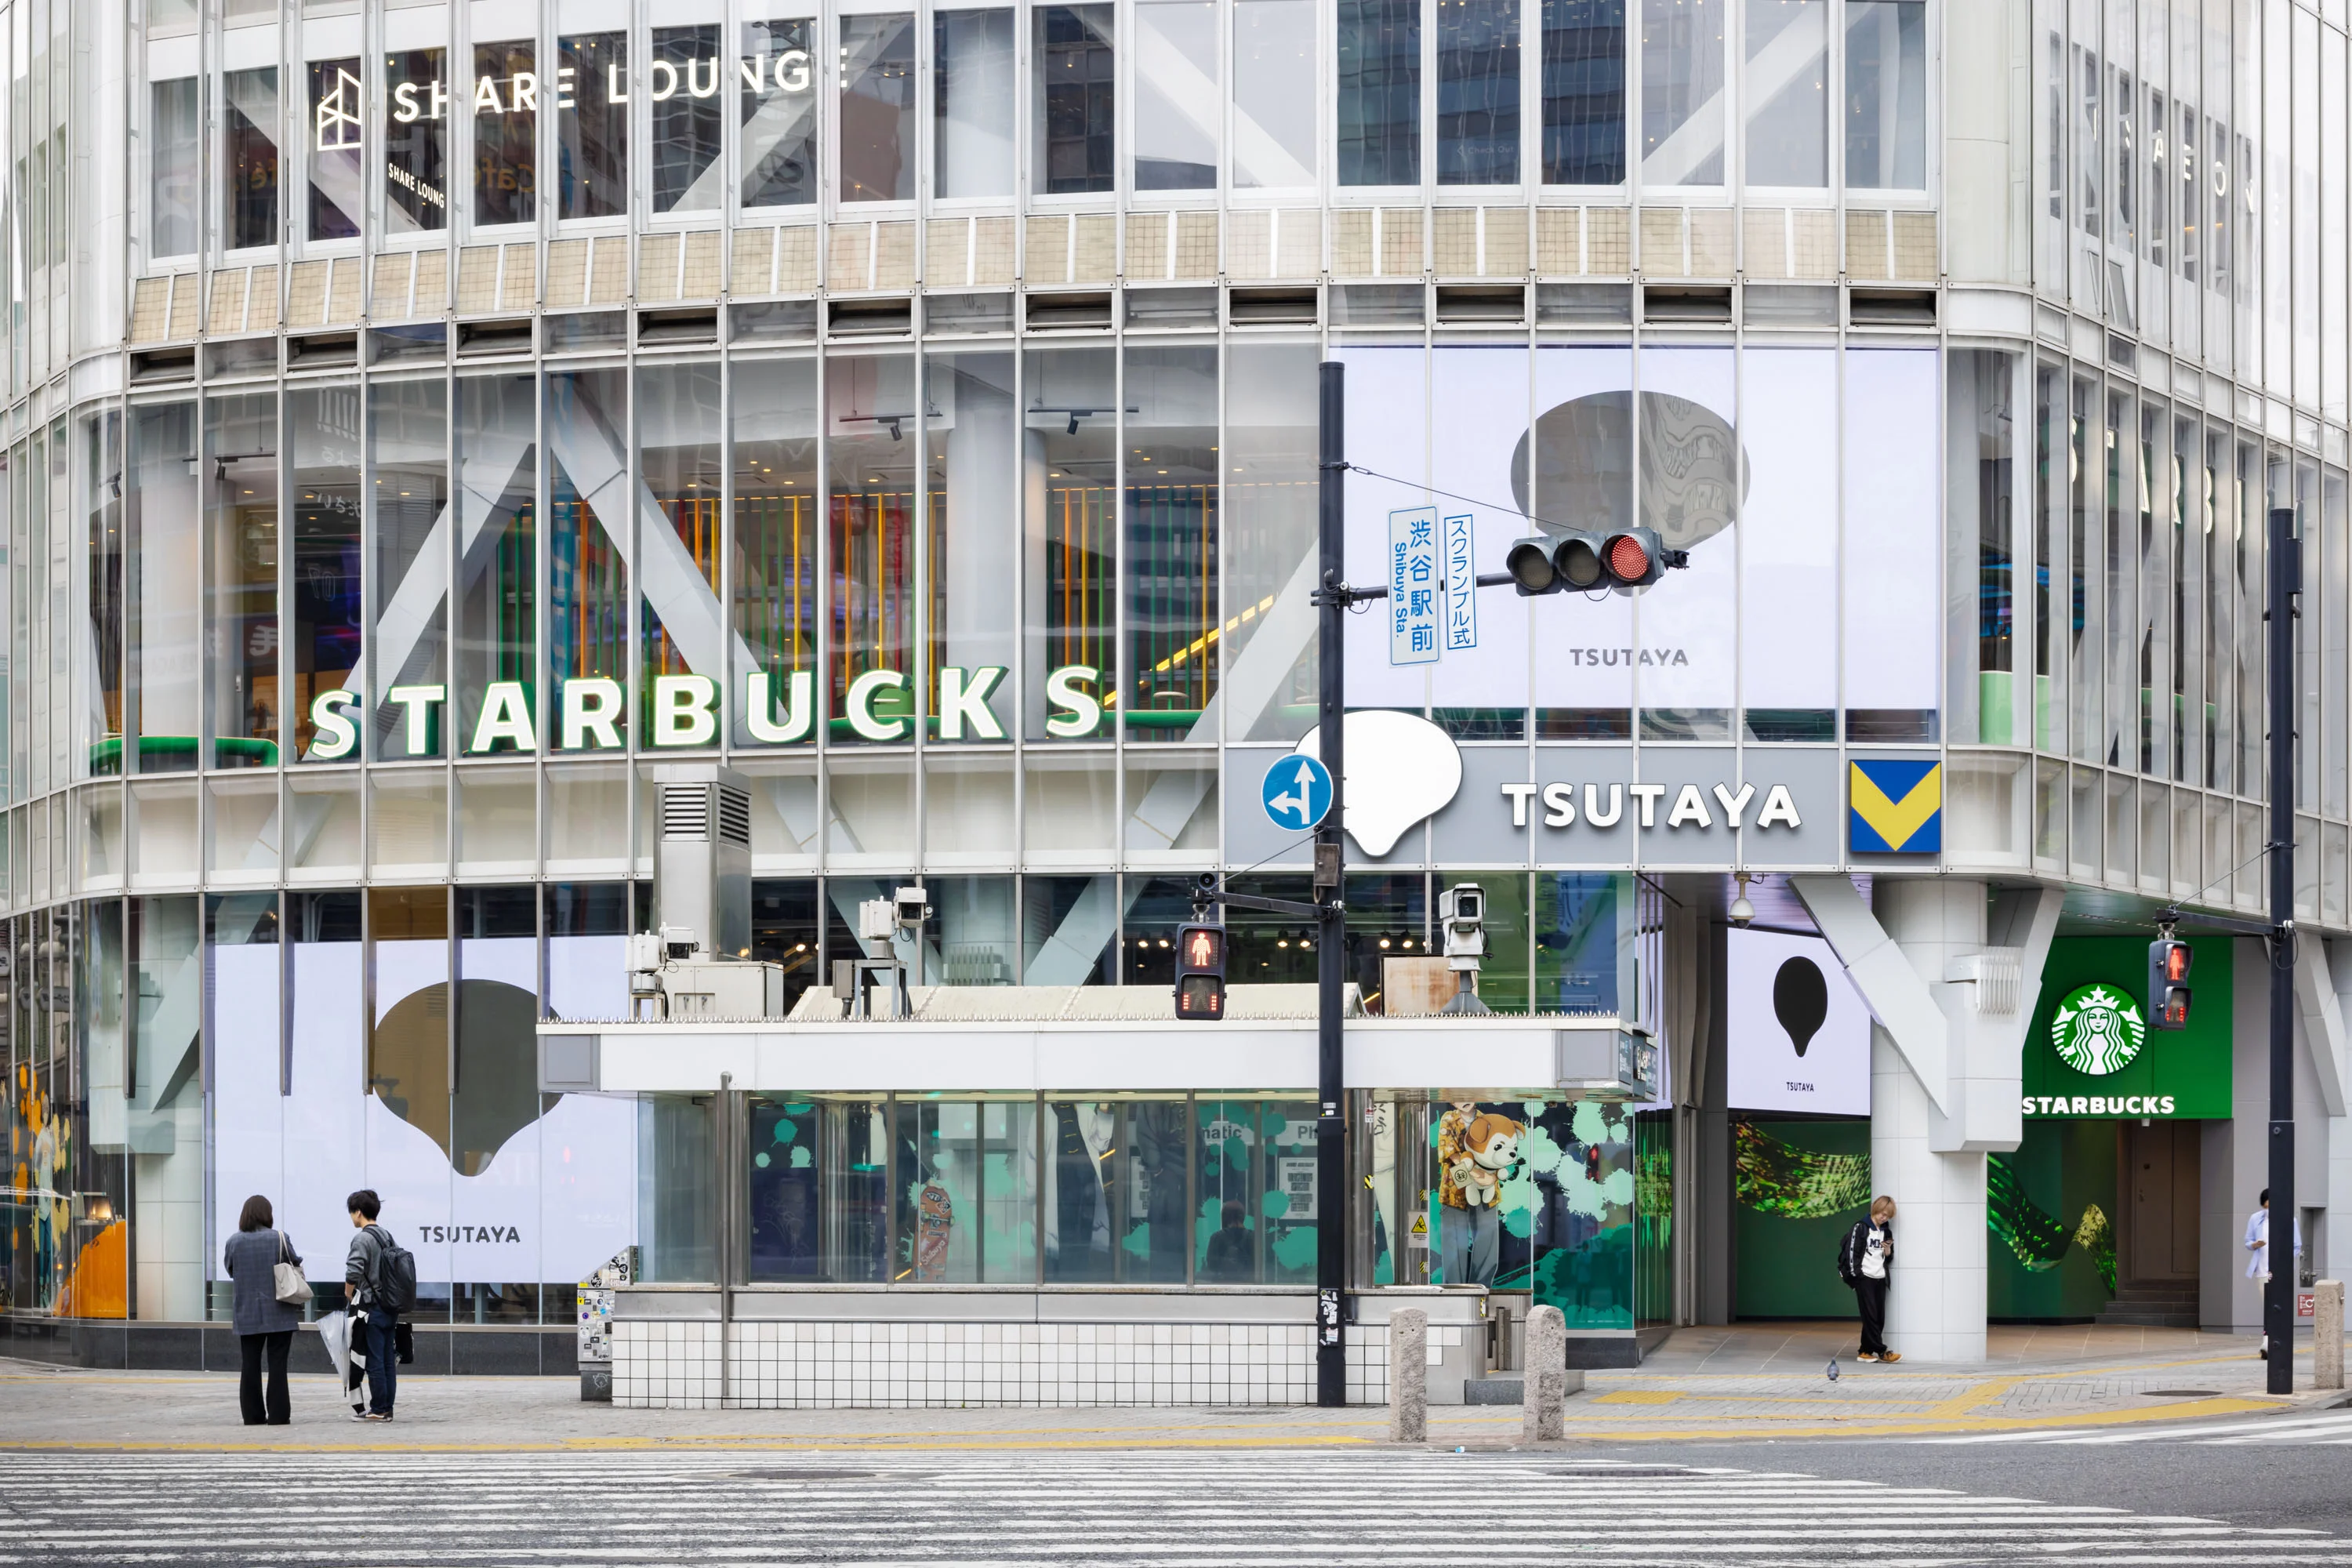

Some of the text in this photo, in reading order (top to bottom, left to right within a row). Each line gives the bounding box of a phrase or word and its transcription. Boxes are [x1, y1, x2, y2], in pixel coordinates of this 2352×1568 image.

[394, 67, 575, 122] SHARE
[388, 162, 415, 191] SHARE
[1393, 542, 1408, 638] Shibuya Sta.
[1410, 519, 1433, 652] 渋谷駅前
[1451, 520, 1470, 645] スクランブル式
[1570, 648, 1689, 666] TSUTAYA
[310, 664, 1105, 759] STARBUCKS
[1501, 782, 1802, 829] TSUTAYA
[1786, 1081, 1814, 1092] TSUTAYA
[2021, 1096, 2176, 1114] STARBUCKS
[419, 1225, 521, 1243] TSUTAYA
[921, 1240, 946, 1265] Shibuya
